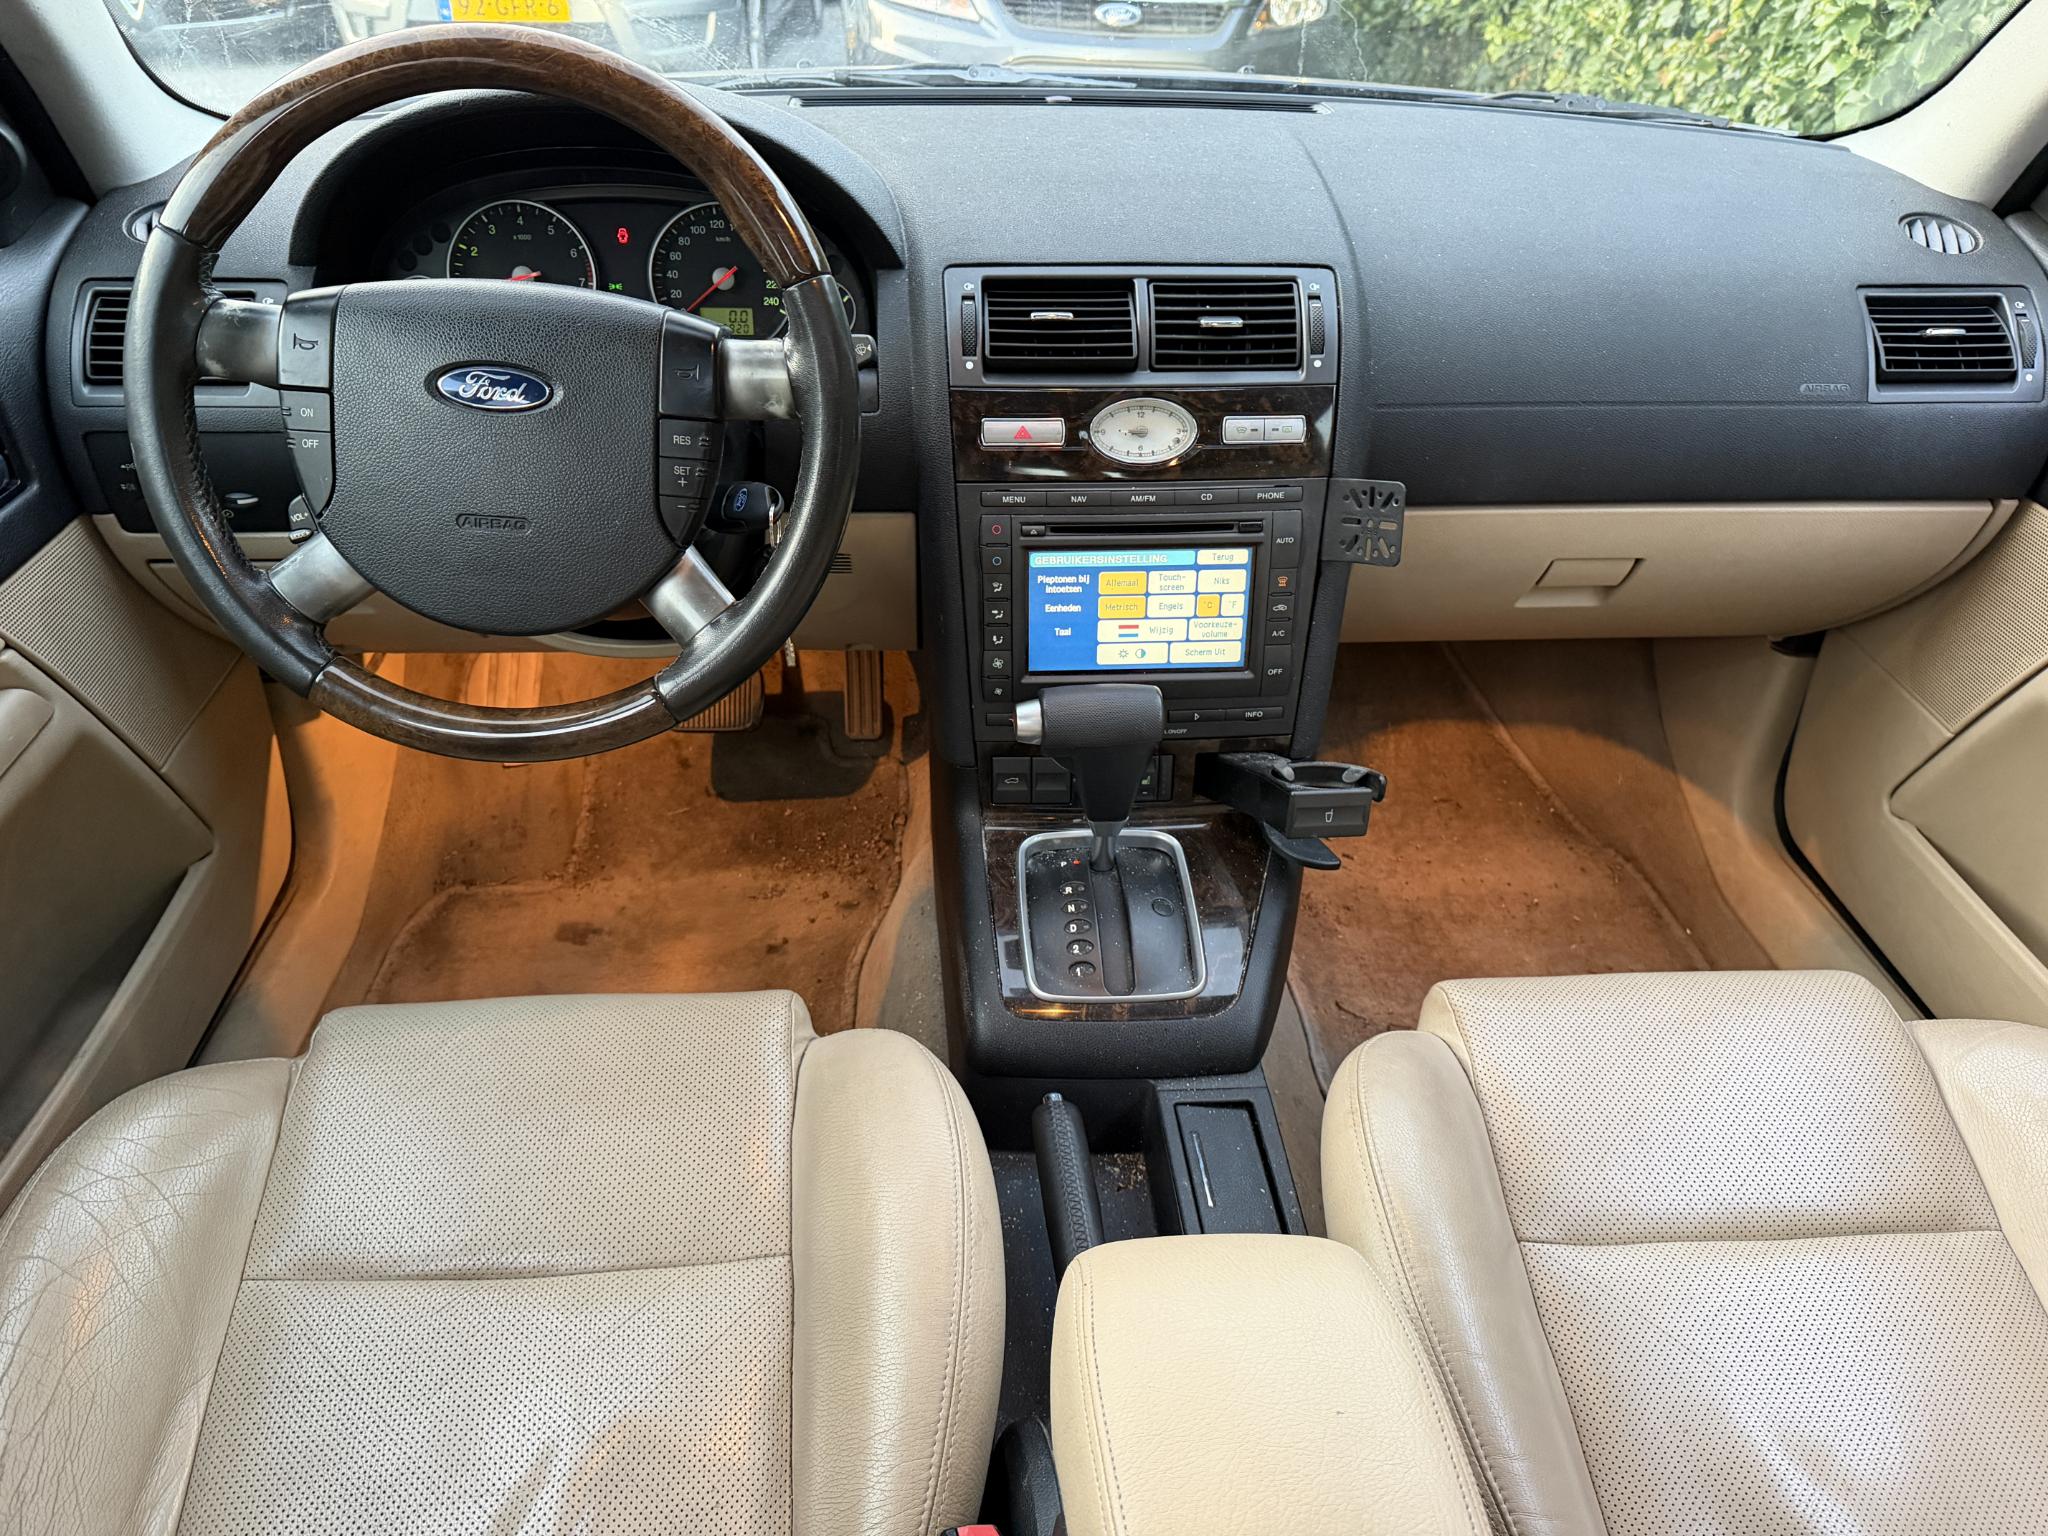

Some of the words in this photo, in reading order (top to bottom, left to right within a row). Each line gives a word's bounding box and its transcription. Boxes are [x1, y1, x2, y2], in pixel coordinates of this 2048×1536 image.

[517, 215, 524, 226] 4
[709, 219, 725, 229] 120
[488, 224, 496, 235] 3
[547, 225, 555, 235] 5
[690, 225, 706, 235] 100
[678, 236, 691, 246] 80
[470, 246, 479, 257] 2
[570, 248, 577, 258] 6
[669, 251, 682, 261] 60
[666, 270, 679, 279] 40
[578, 278, 585, 287] 7
[765, 279, 779, 289] 22
[670, 289, 682, 299] 20
[763, 296, 780, 306] 240
[728, 310, 749, 324] 0.0
[458, 371, 531, 404] Ford
[300, 407, 314, 417] ON
[301, 438, 319, 449] OFF
[673, 435, 692, 446] RES
[673, 465, 691, 476] SET
[1002, 495, 1026, 504] MENU
[1071, 495, 1087, 504] NAV
[1130, 494, 1156, 504] AM/FM
[1201, 493, 1213, 501] CD
[1257, 491, 1286, 501] PHONE
[461, 516, 530, 530] AIRBAG
[1276, 536, 1295, 545] AUTO
[1034, 554, 1169, 566] GEBRUIKERSINSTELLING
[1212, 553, 1235, 562] Terug
[1078, 574, 1090, 585] bij
[1105, 578, 1140, 588] Allemaal
[1213, 576, 1231, 586] Niks
[1159, 584, 1186, 592] screen
[1105, 602, 1139, 612] Metrisch
[1158, 602, 1185, 612] Engels
[1054, 627, 1072, 637] Taal
[1149, 626, 1175, 636] Wijzig
[1201, 630, 1229, 639] volume
[1271, 629, 1286, 638] A/C
[1184, 648, 1213, 657] Scherm
[1215, 647, 1227, 656] Uit
[1267, 667, 1284, 677] OFF
[1245, 710, 1264, 719] INFO
[1065, 886, 1073, 894] R
[1067, 904, 1076, 912] N
[1069, 923, 1077, 932] D
[1072, 944, 1080, 954] 2
[1075, 967, 1082, 977] 1
